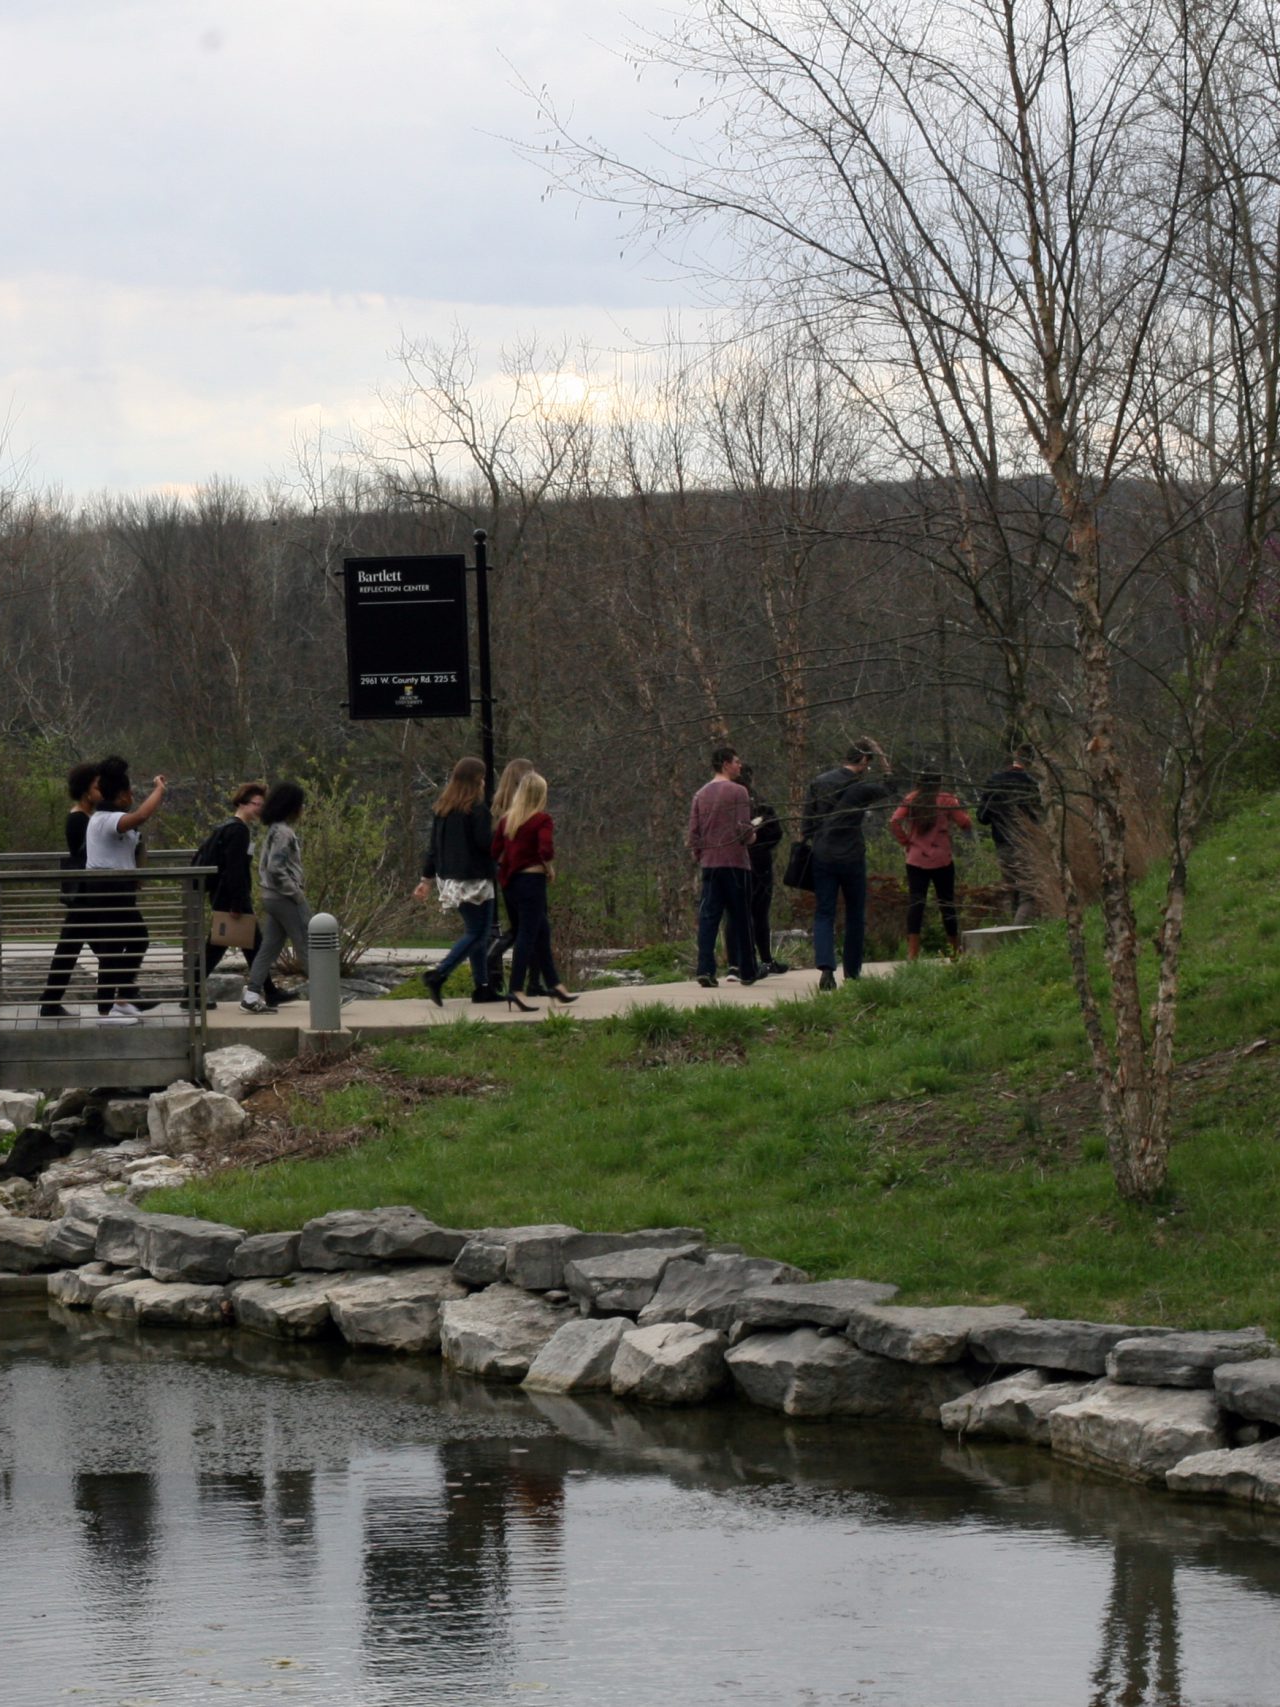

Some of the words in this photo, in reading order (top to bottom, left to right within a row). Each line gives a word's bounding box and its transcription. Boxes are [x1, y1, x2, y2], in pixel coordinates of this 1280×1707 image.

[358, 569, 402, 583] Bartlett
[359, 585, 402, 593] REFLECTION
[403, 584, 430, 592] CENTER
[360, 677, 378, 685] 2961
[392, 676, 418, 685] County
[420, 675, 431, 683] Rd.
[434, 675, 448, 683] 225
